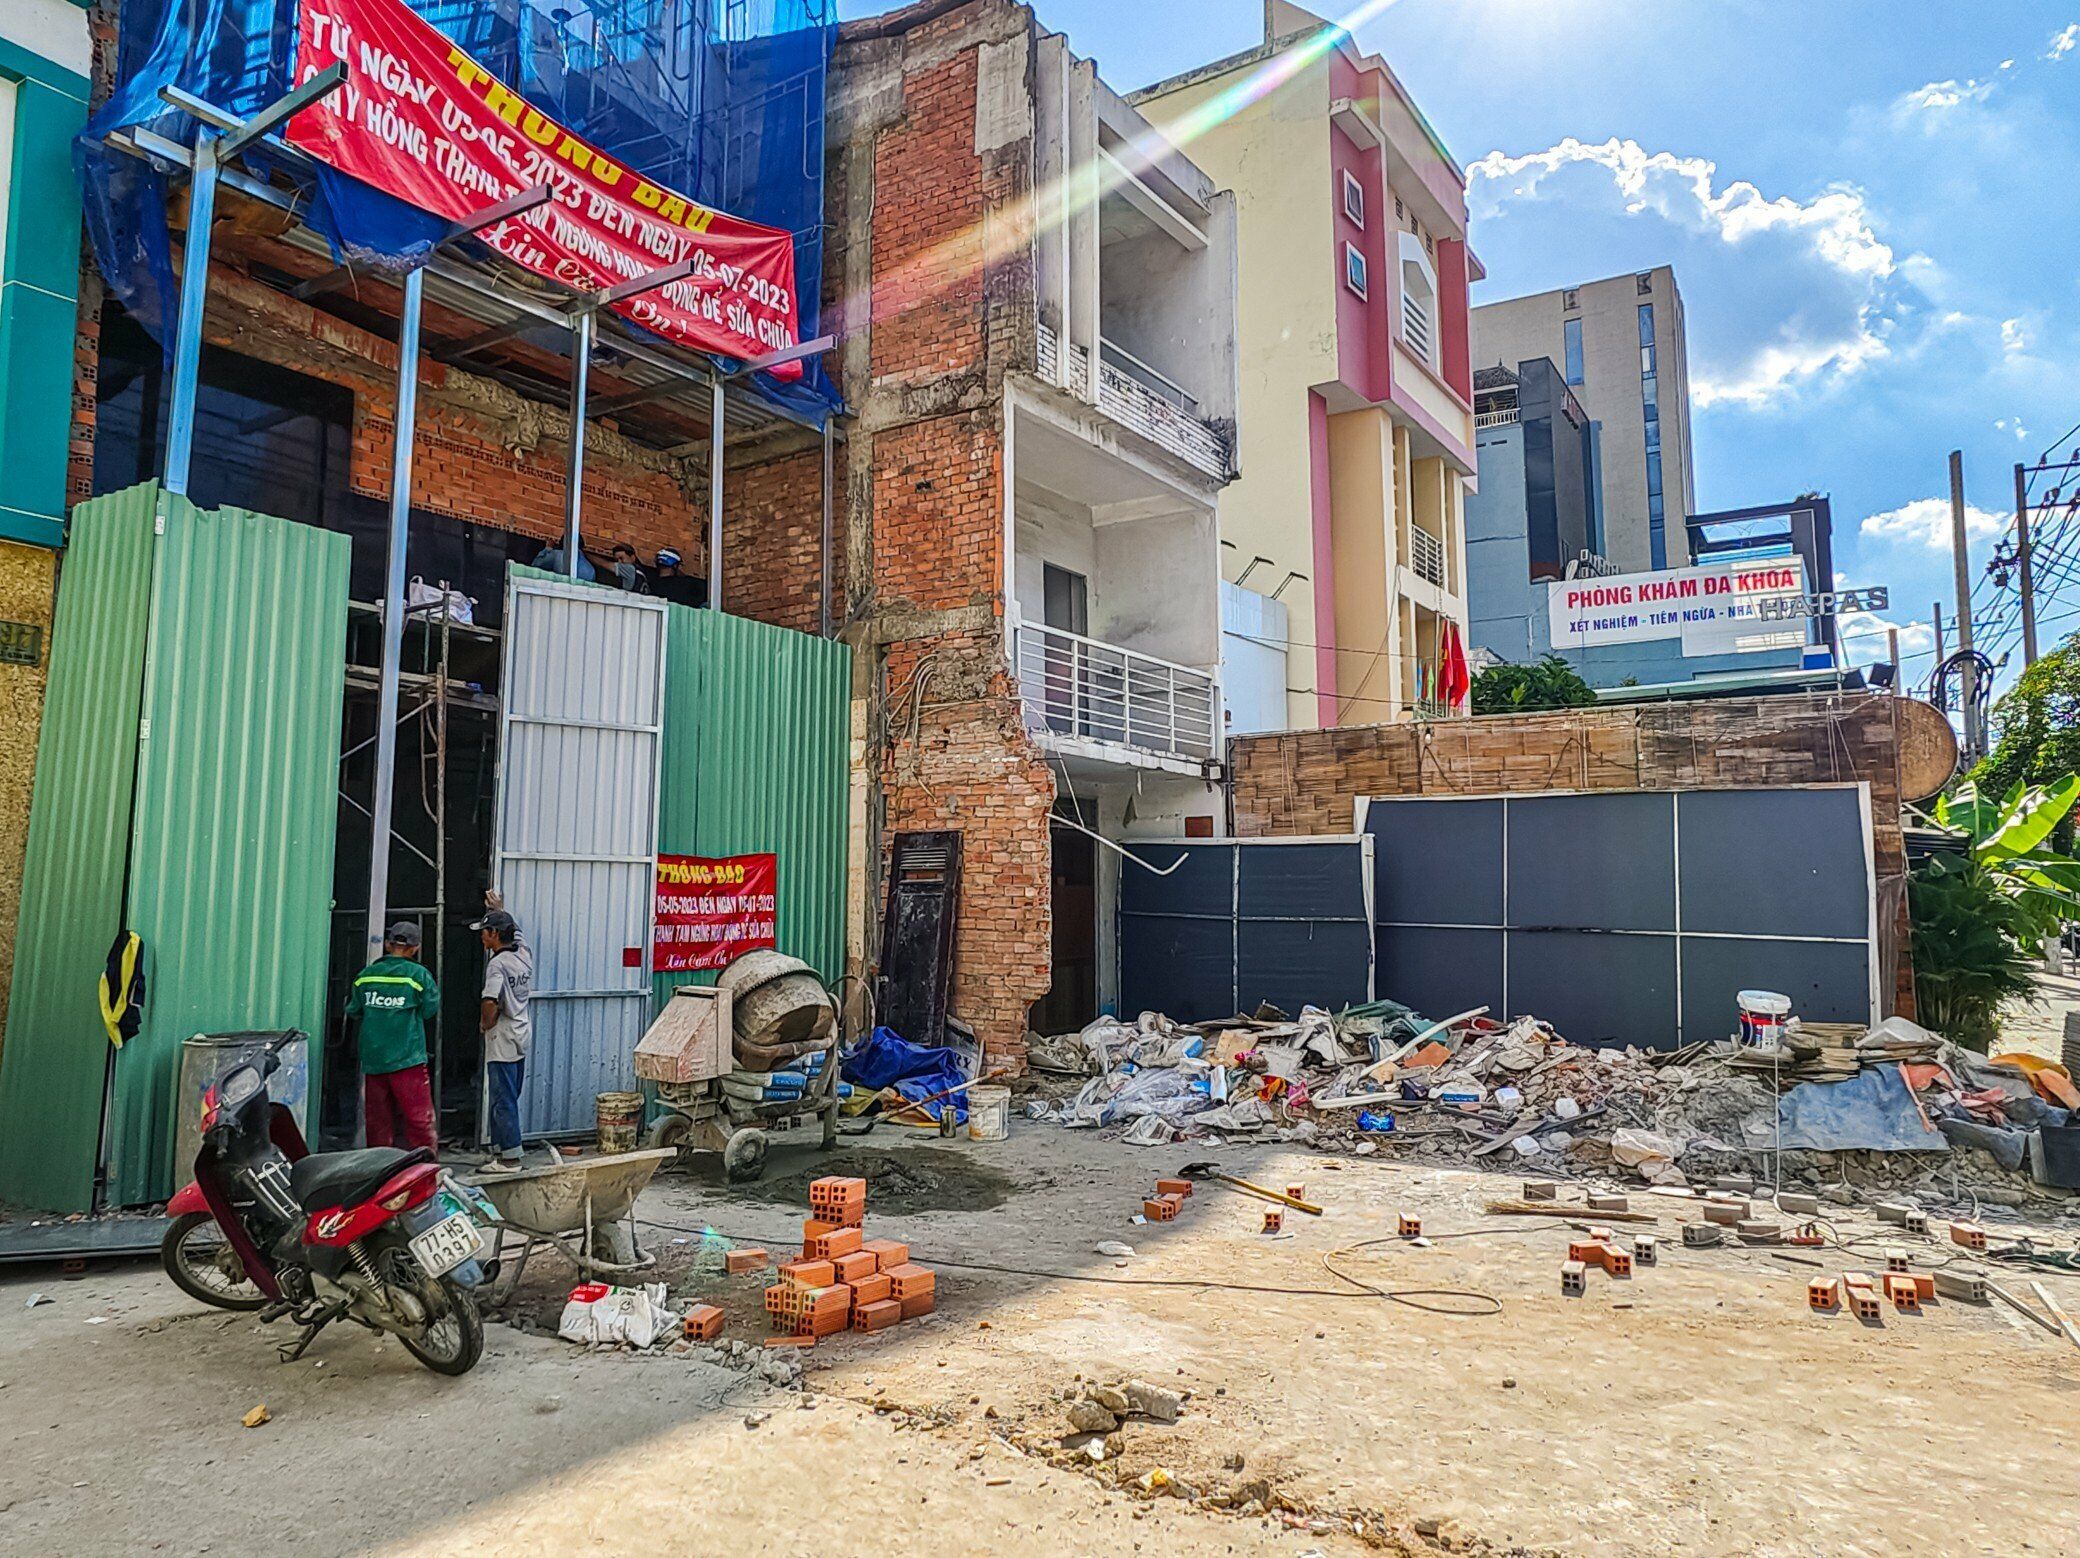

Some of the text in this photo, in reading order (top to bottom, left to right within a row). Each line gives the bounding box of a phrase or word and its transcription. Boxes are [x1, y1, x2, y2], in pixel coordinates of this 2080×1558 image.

[309, 9, 353, 60] TỪ
[360, 40, 437, 105] NGÀY
[637, 218, 692, 264] NGÀY
[693, 249, 790, 315] 05-07-2023
[366, 97, 429, 165] HỒNG
[726, 298, 756, 340] SỬA
[758, 319, 793, 351] CHỮA
[484, 221, 548, 270] Xin
[1567, 569, 1795, 609] PHÒNG KHÁM ĐA KHOA
[1760, 586, 1889, 621] HAPAS
[1593, 614, 1638, 631] NGHIỆM
[658, 860, 745, 884] THÔNG BÁO
[432, 1234, 477, 1269] 0397
